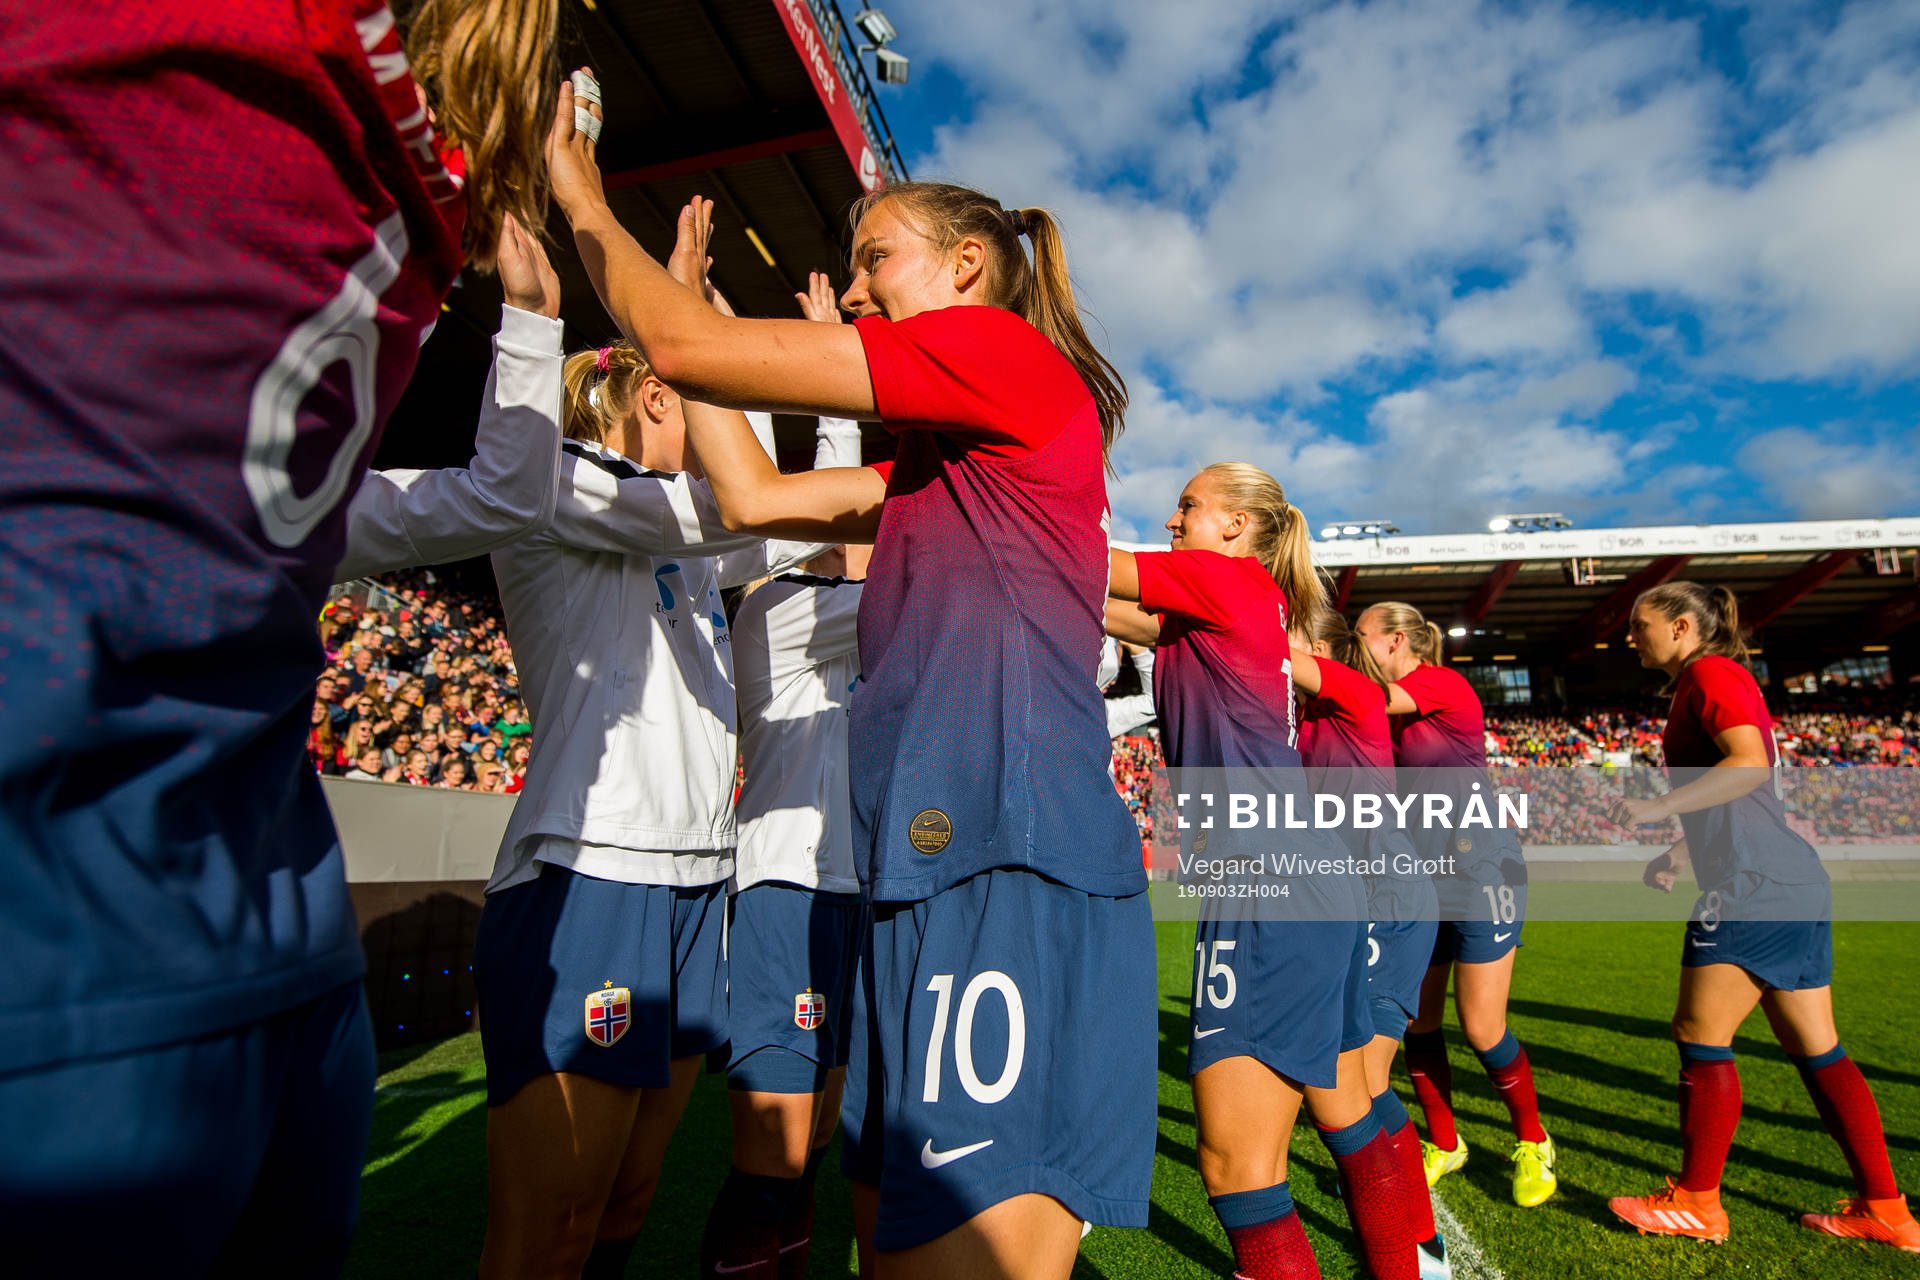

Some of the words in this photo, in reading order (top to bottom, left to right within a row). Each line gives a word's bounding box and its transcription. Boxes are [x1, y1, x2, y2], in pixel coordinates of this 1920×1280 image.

[1386, 546, 1410, 556] BOB
[1501, 541, 1526, 551] BOB
[1483, 885, 1516, 925] 18
[1700, 891, 1722, 932] 8
[1196, 940, 1238, 1010] 15
[923, 971, 1026, 1104] 10
